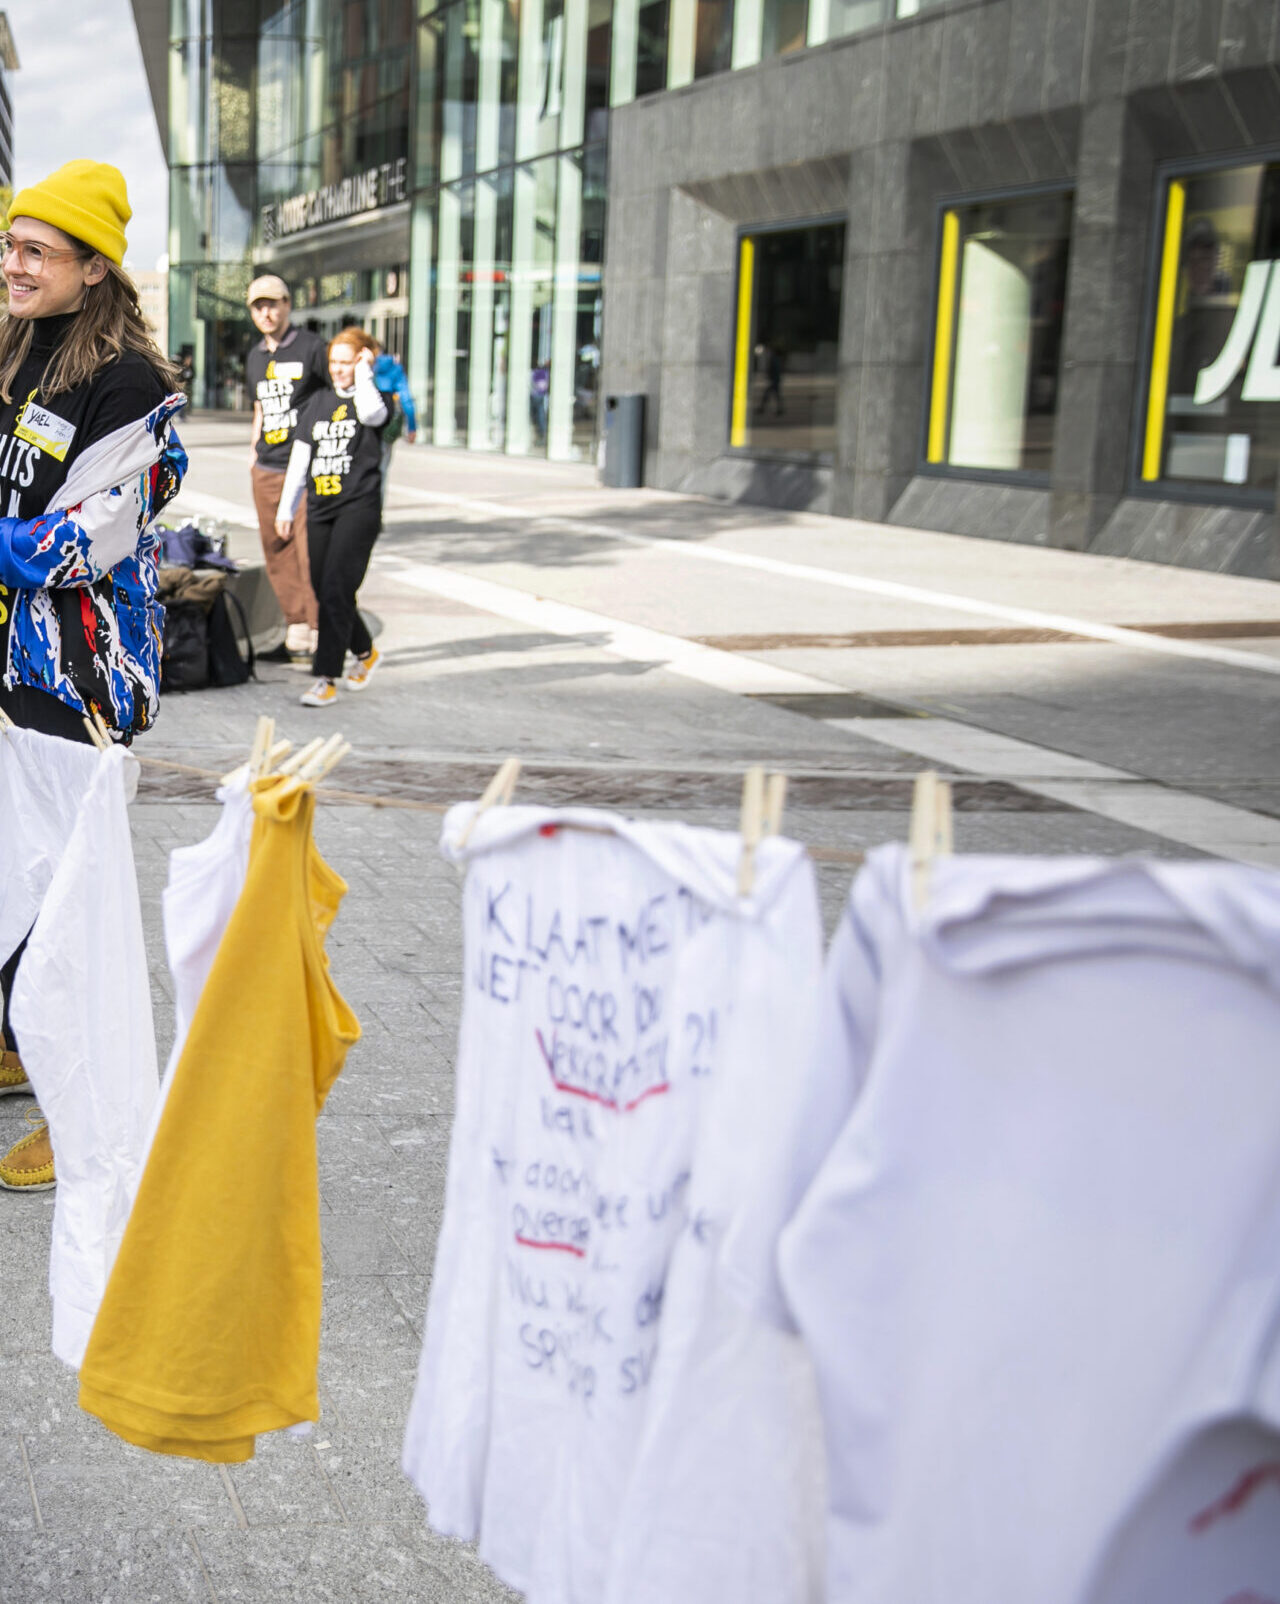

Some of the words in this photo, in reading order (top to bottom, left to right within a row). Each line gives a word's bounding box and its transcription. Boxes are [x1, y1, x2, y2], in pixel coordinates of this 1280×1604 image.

[26, 409, 51, 428] YAEL
[312, 418, 357, 441] #LETS
[314, 474, 342, 496] YES
